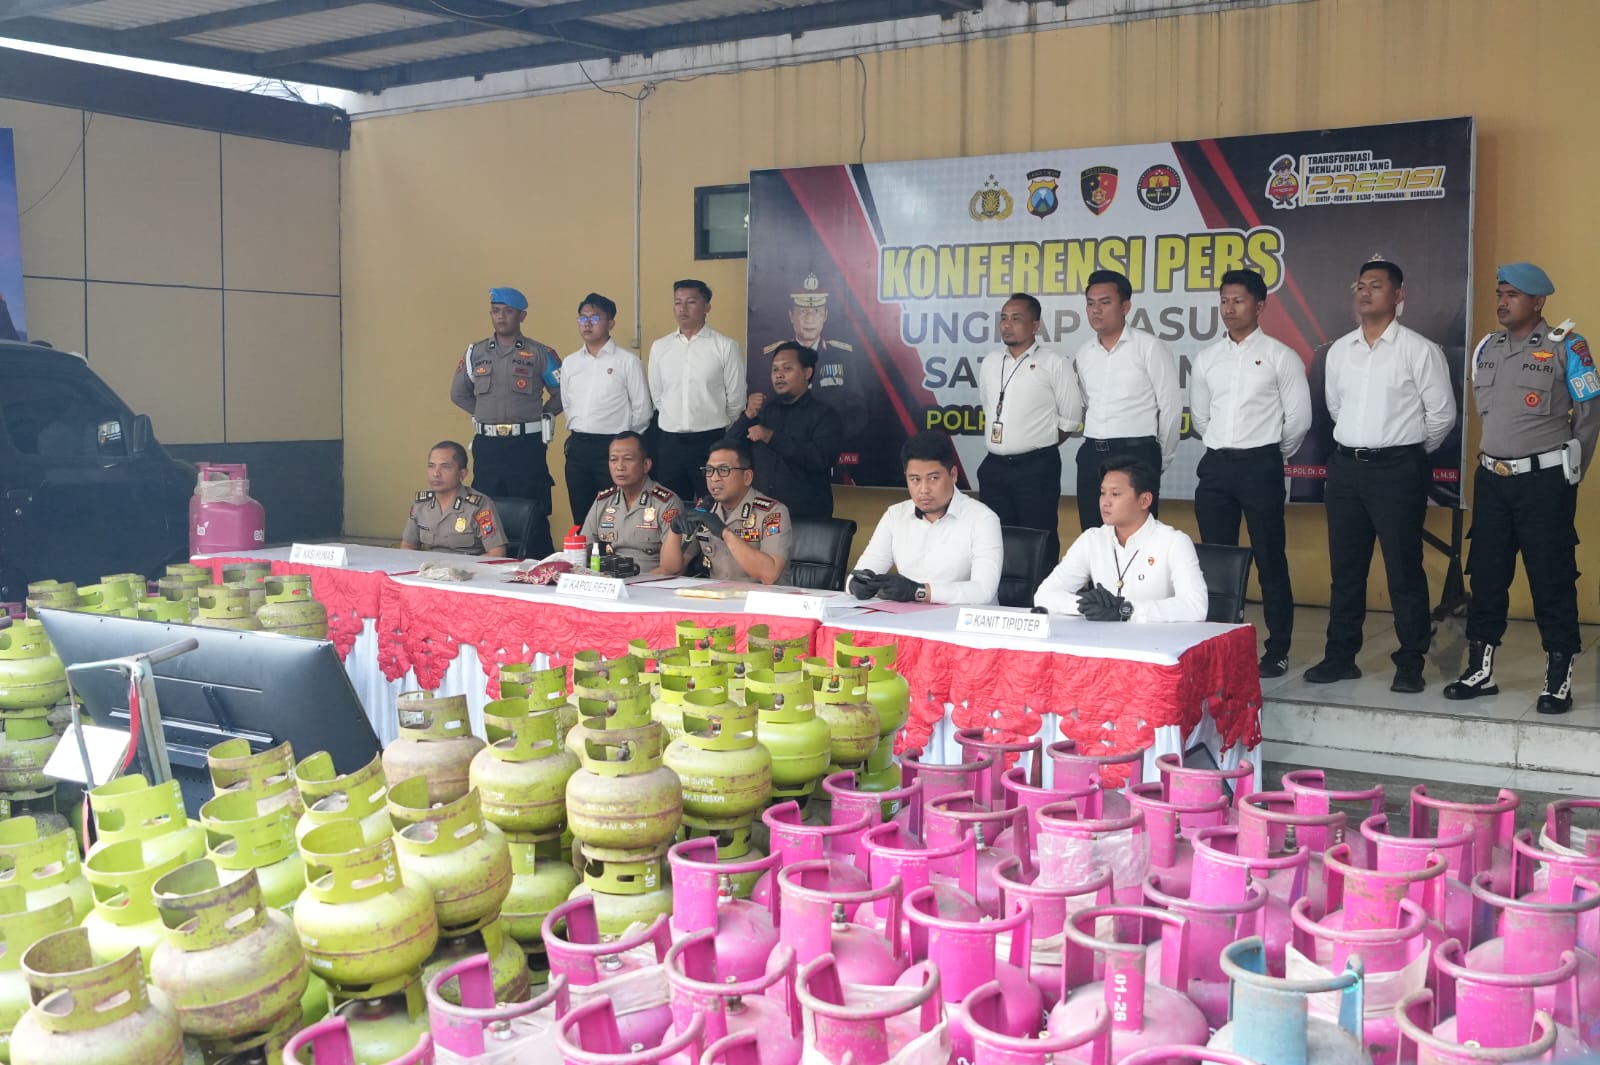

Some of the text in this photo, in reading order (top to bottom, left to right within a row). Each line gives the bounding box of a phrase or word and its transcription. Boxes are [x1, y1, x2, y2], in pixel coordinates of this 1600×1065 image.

[1308, 152, 1371, 165] TRANSFORMASI
[1308, 161, 1390, 174] MENUJU POLRI YANG
[1308, 168, 1444, 195] PRESISI
[880, 230, 1280, 299] KONFERENSI PERS
[1131, 306, 1228, 341] ASU
[1522, 363, 1554, 373] POLRI
[569, 579, 616, 595] KAPOLRESTA
[974, 614, 1041, 632] KANIT TIPIDTER
[1114, 973, 1128, 1022] 01-26
